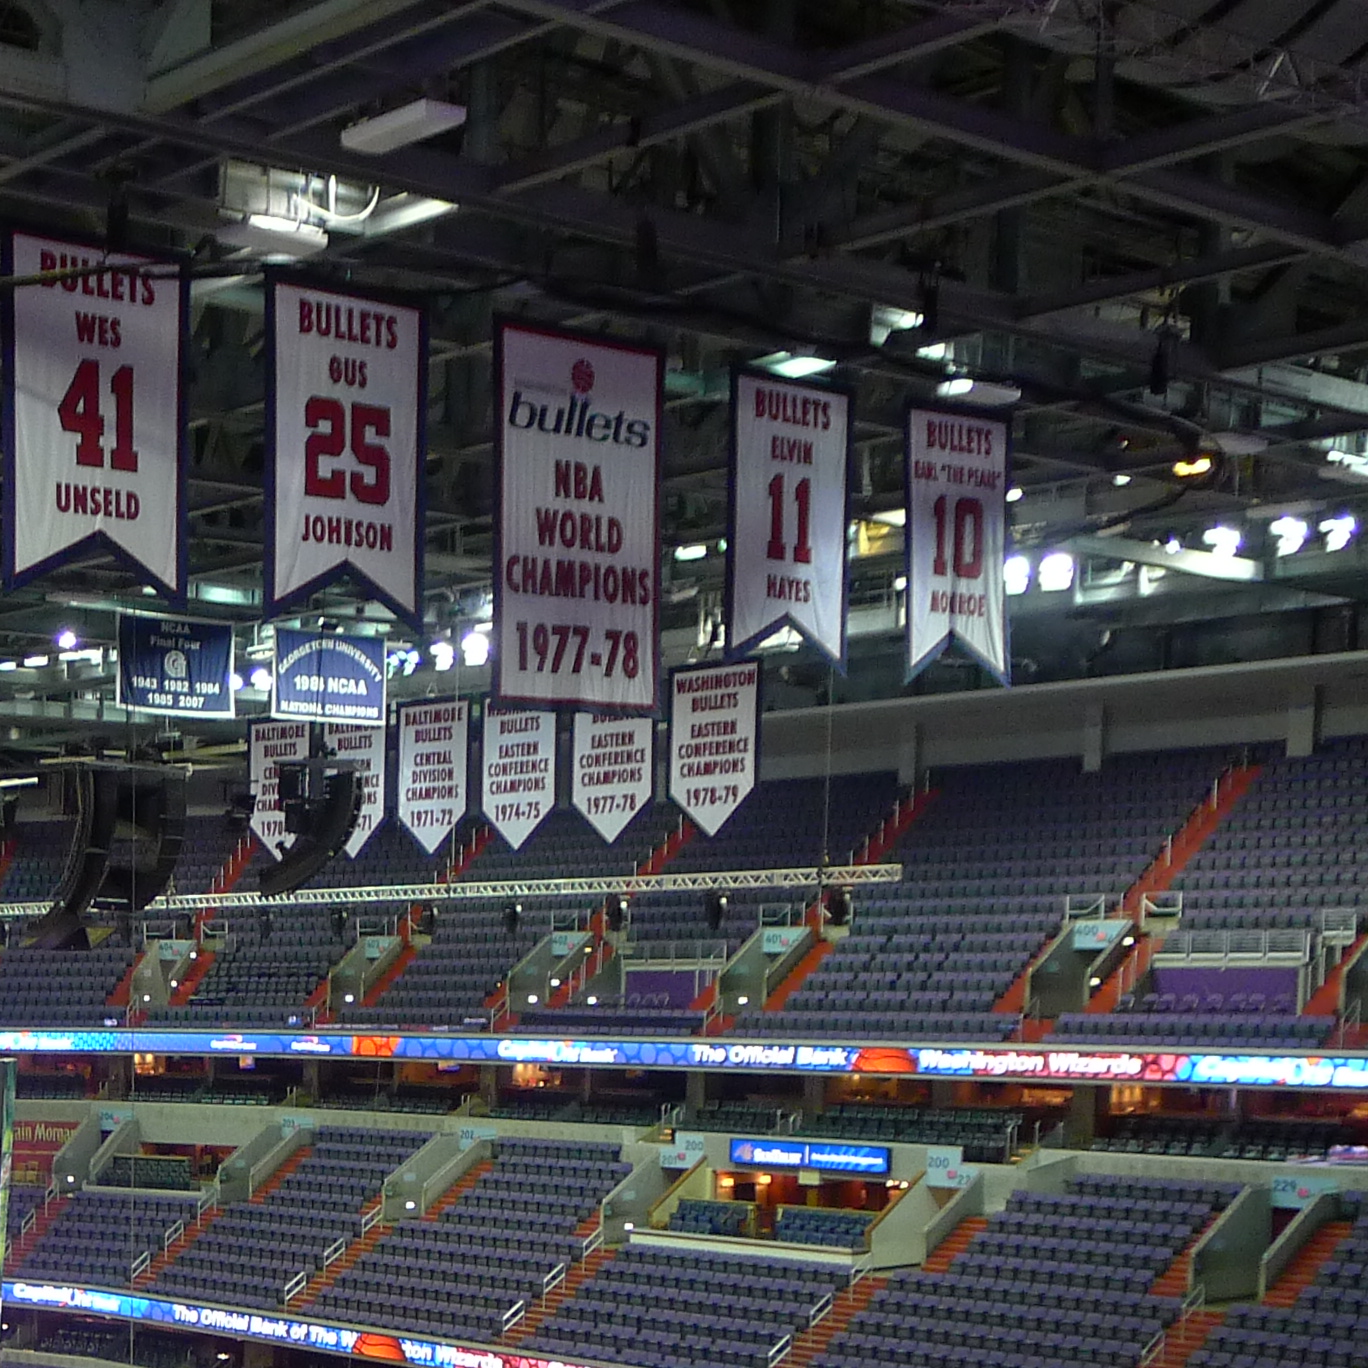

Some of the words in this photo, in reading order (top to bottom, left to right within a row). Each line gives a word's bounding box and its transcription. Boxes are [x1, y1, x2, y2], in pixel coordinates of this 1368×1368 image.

[75, 312, 121, 348] WES
[299, 299, 398, 349] BULLETS
[329, 355, 367, 388] GUS
[57, 358, 138, 472] 41
[507, 390, 651, 449] bullets
[754, 388, 831, 431] BULLETS
[926, 420, 993, 457] BULLETS
[305, 395, 391, 507] 25
[771, 435, 814, 465] ELVIN
[554, 460, 605, 503] NBA
[55, 482, 140, 520] UNSELD
[766, 473, 812, 564] 11
[302, 515, 393, 552] JOHNSON
[535, 507, 623, 554] WORLD
[933, 494, 984, 579] 10
[506, 555, 650, 606] CHAMPIONS
[766, 573, 812, 604] HAYES
[516, 621, 640, 679] 1977-78
[327, 677, 368, 695] NCAA
[676, 668, 757, 695] WASHINGTON
[178, 695, 205, 708] 2007
[324, 703, 379, 718] CHAMPIONS
[691, 692, 739, 713] BULLETS
[404, 706, 463, 727] BALTIMORE
[499, 716, 540, 735] BULLETS
[255, 724, 305, 742] BALTIMORE
[414, 726, 453, 743] BULLETS
[690, 718, 738, 739] EASTERN
[264, 742, 297, 758] BULLETS
[337, 735, 373, 751] BULLETS
[498, 741, 539, 760] EASTERN
[591, 731, 635, 750] EASTERN
[678, 737, 749, 760] CONFERENCE
[414, 750, 453, 767] CENTRAL
[488, 757, 549, 778] CONFERENCE
[579, 748, 646, 769] CONFERENCE
[679, 757, 746, 778] CHAMPIONS
[412, 767, 454, 784] DIVISION
[489, 776, 546, 796] CHAMPIONS
[581, 767, 643, 787] CHAMPIONS
[405, 784, 459, 803] CHAMPIONS
[586, 793, 637, 815] 1977-78
[686, 784, 740, 808] 1978-79
[410, 809, 453, 828] 1971-72
[494, 802, 541, 823] 1974-75
[692, 1043, 732, 1064] The
[734, 1044, 796, 1066] Official
[799, 1046, 849, 1067] Bank
[918, 1049, 1044, 1076] Washington
[1048, 1051, 1143, 1075] Wizards
[685, 1140, 704, 1151] 200
[928, 1156, 949, 1168] 200
[172, 1304, 199, 1324] The
[200, 1309, 250, 1333] Official
[250, 1315, 288, 1339] Bank
[290, 1323, 309, 1341] of
[309, 1326, 338, 1346] The
